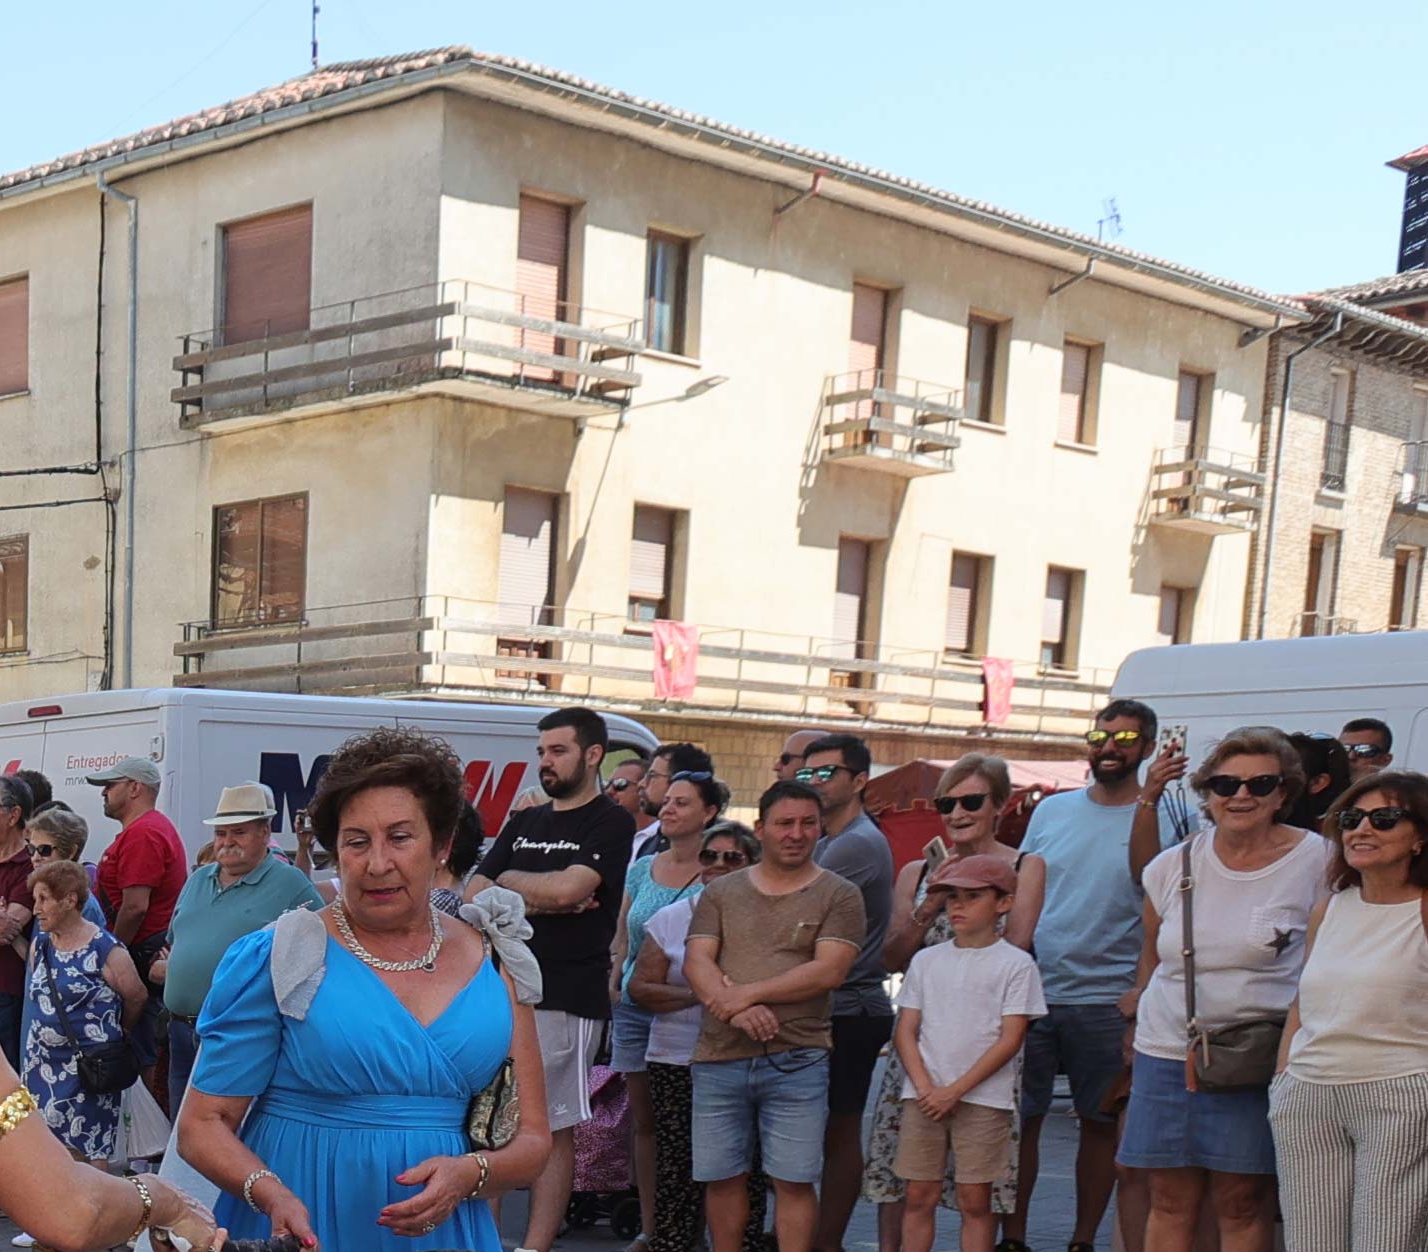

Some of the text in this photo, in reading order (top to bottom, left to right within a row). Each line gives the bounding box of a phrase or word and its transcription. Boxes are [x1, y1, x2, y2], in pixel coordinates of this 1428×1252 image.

[66, 751, 129, 771] Entregado
[259, 752, 529, 838] MW
[512, 836, 580, 854] Champion
